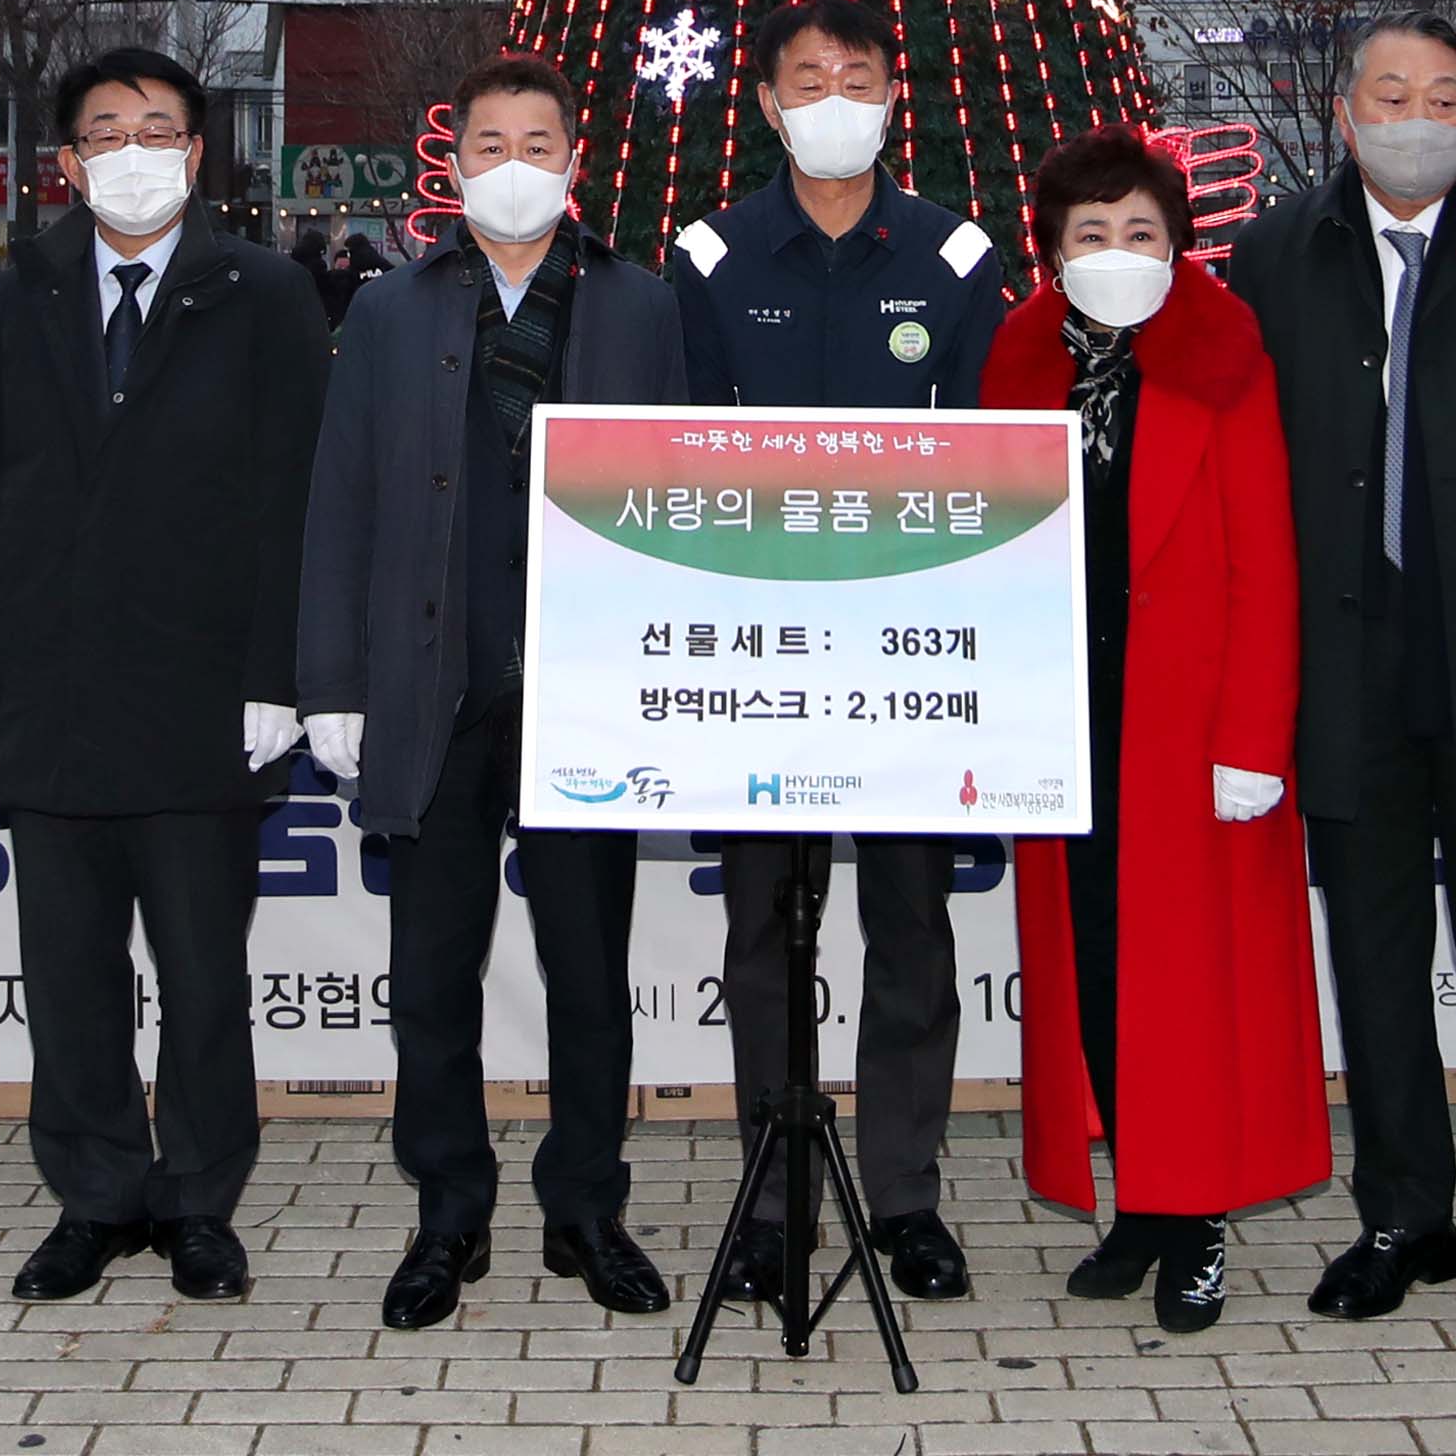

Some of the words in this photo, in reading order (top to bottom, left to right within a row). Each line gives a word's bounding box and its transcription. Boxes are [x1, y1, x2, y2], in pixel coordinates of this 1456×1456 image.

[762, 432, 806, 453] 세상
[816, 431, 884, 455] 행복한
[615, 487, 754, 532] 사랑의
[780, 489, 872, 534] 물품
[896, 490, 989, 535] 전달
[880, 626, 978, 661] 363개
[640, 687, 810, 722] 방역마스크
[846, 690, 979, 725] 2,192매
[626, 766, 676, 809] 동구
[785, 775, 862, 789] HYUNDAI
[785, 791, 841, 805] STEEL
